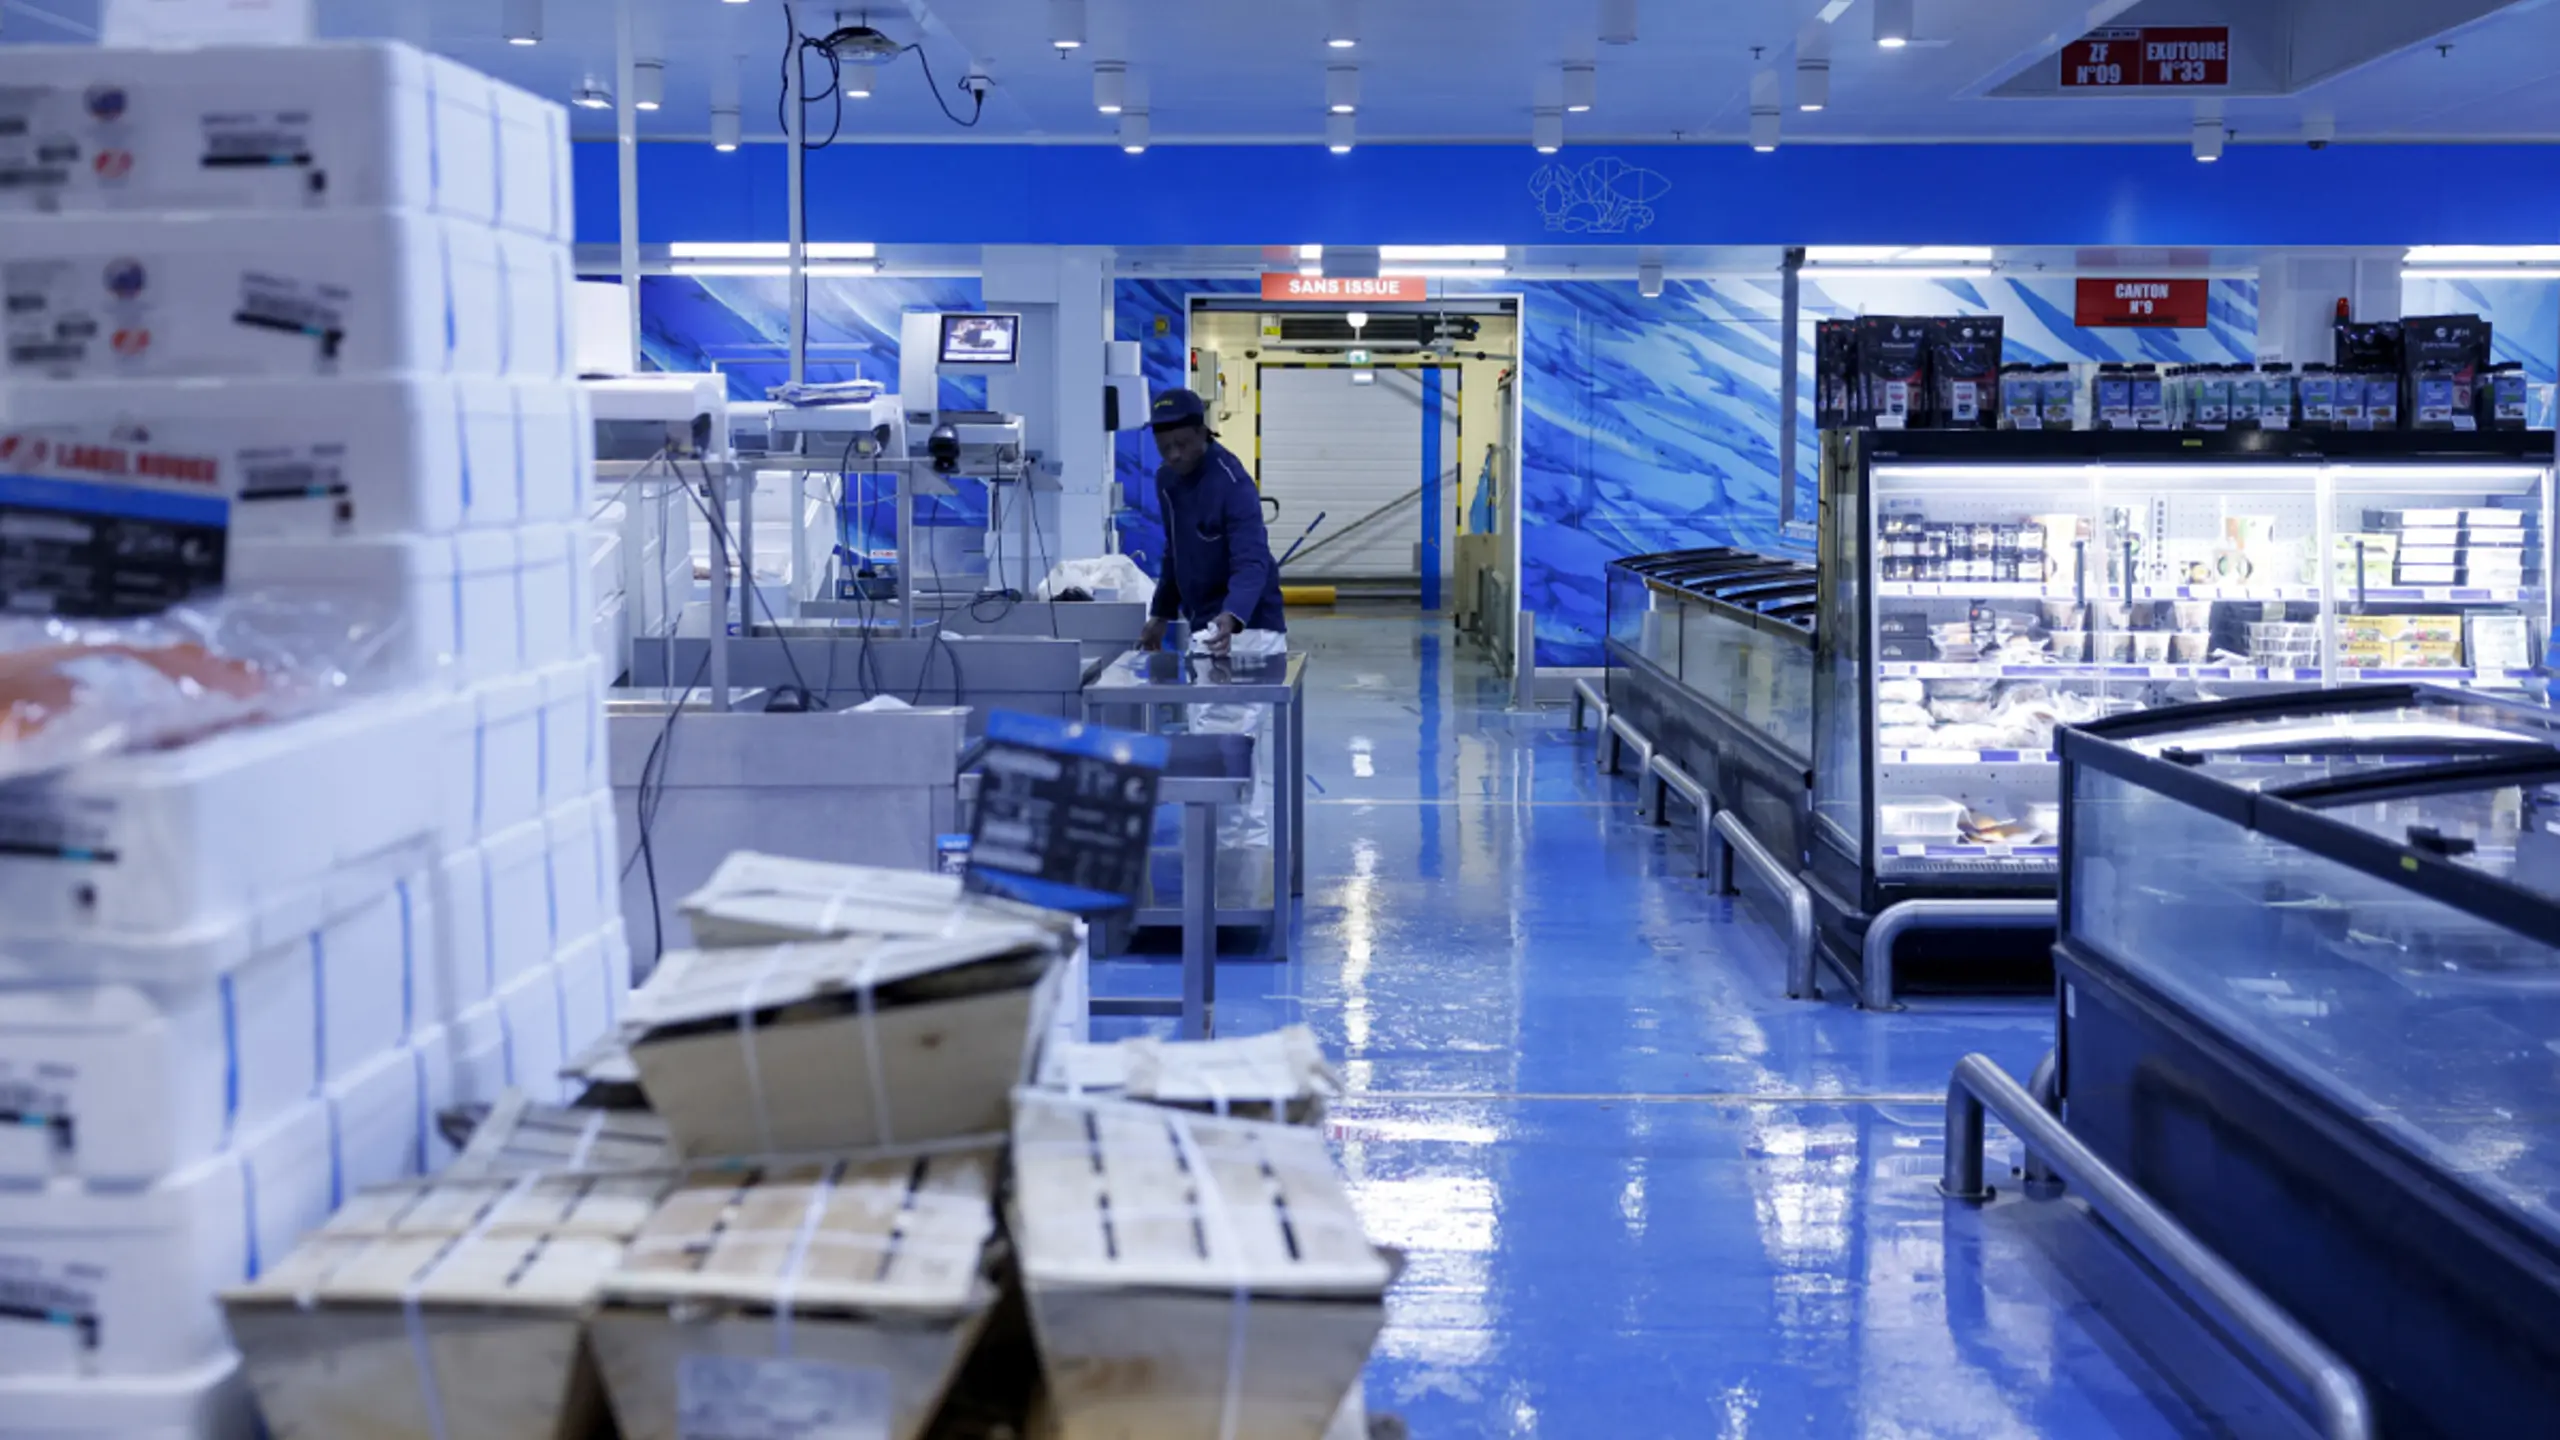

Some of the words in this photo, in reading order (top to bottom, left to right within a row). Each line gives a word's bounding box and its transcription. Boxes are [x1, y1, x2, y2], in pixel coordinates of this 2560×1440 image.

[2089, 42, 2109, 63] ZF
[2147, 41, 2226, 61] EXUTOIRE
[2076, 63, 2122, 84] N°09
[2159, 61, 2206, 82] N°33
[1288, 278, 1339, 295] SANS
[1345, 279, 1400, 295] ISSUE
[2115, 283, 2169, 299] CANTON
